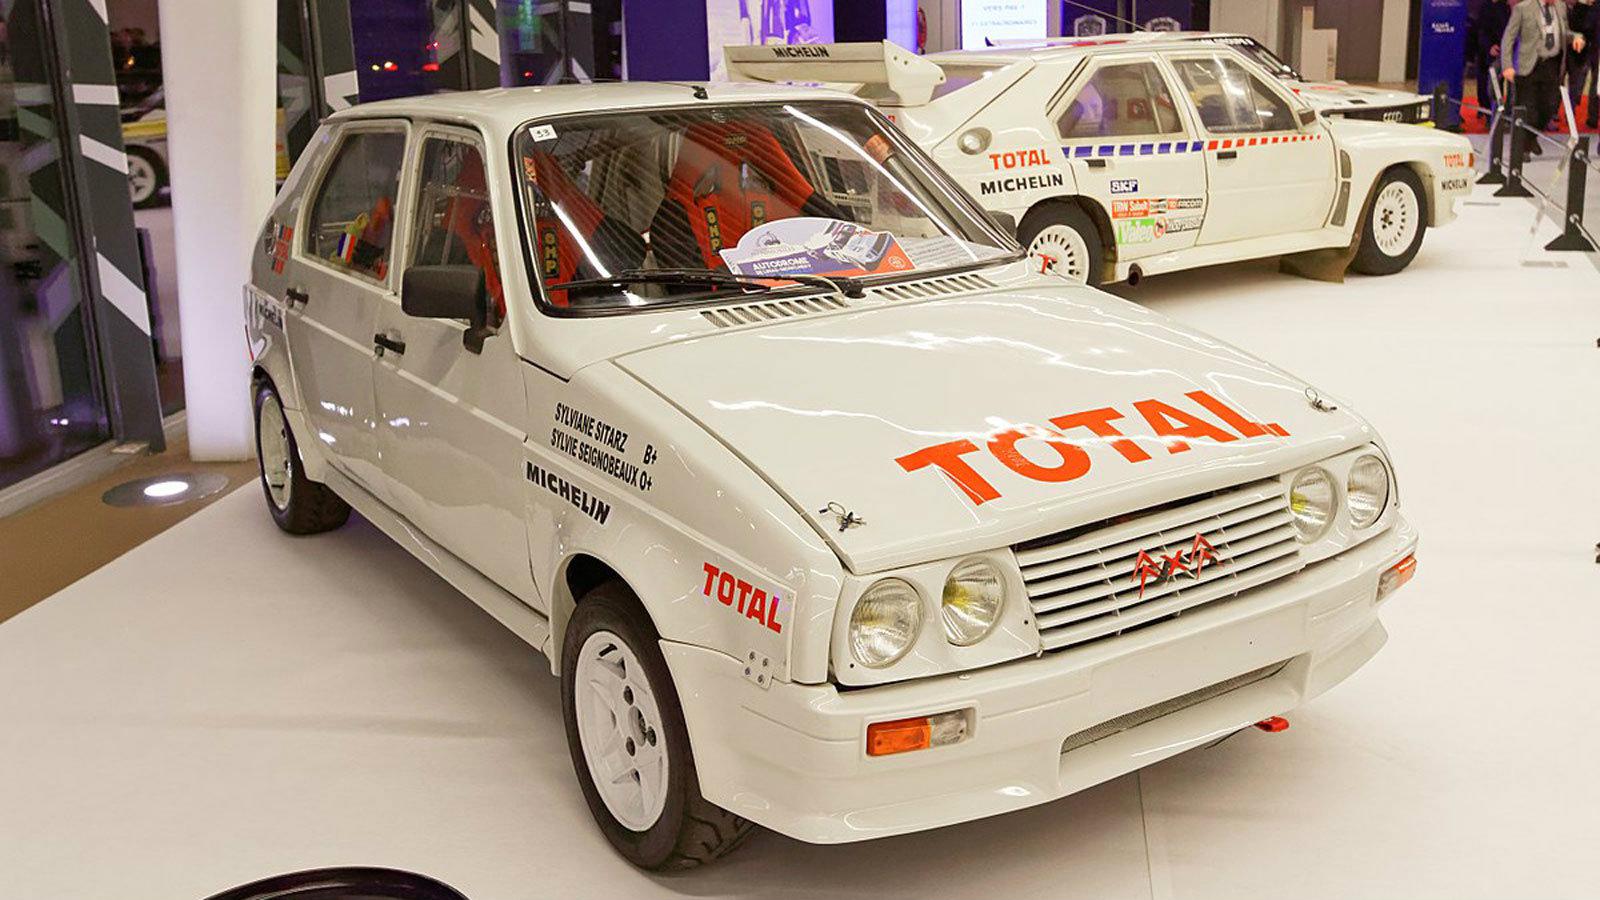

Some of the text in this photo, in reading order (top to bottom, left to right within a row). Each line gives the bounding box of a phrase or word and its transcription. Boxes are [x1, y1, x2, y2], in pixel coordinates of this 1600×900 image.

[772, 46, 830, 58] MICHELIN
[989, 149, 1051, 170] TOTAL
[980, 174, 1063, 195] MICHELIN
[1111, 180, 1137, 192] SKF
[544, 232, 557, 273] OMP
[752, 256, 810, 270] AUTODROME
[554, 402, 657, 465] SYLVIANE SITARZ B+
[895, 390, 1290, 505] TOTAL
[551, 428, 579, 457] SYLVIE
[578, 442, 639, 487] SEIGNOBEAUX
[526, 461, 611, 525] MICHELIN
[703, 561, 782, 634] TOTAL
